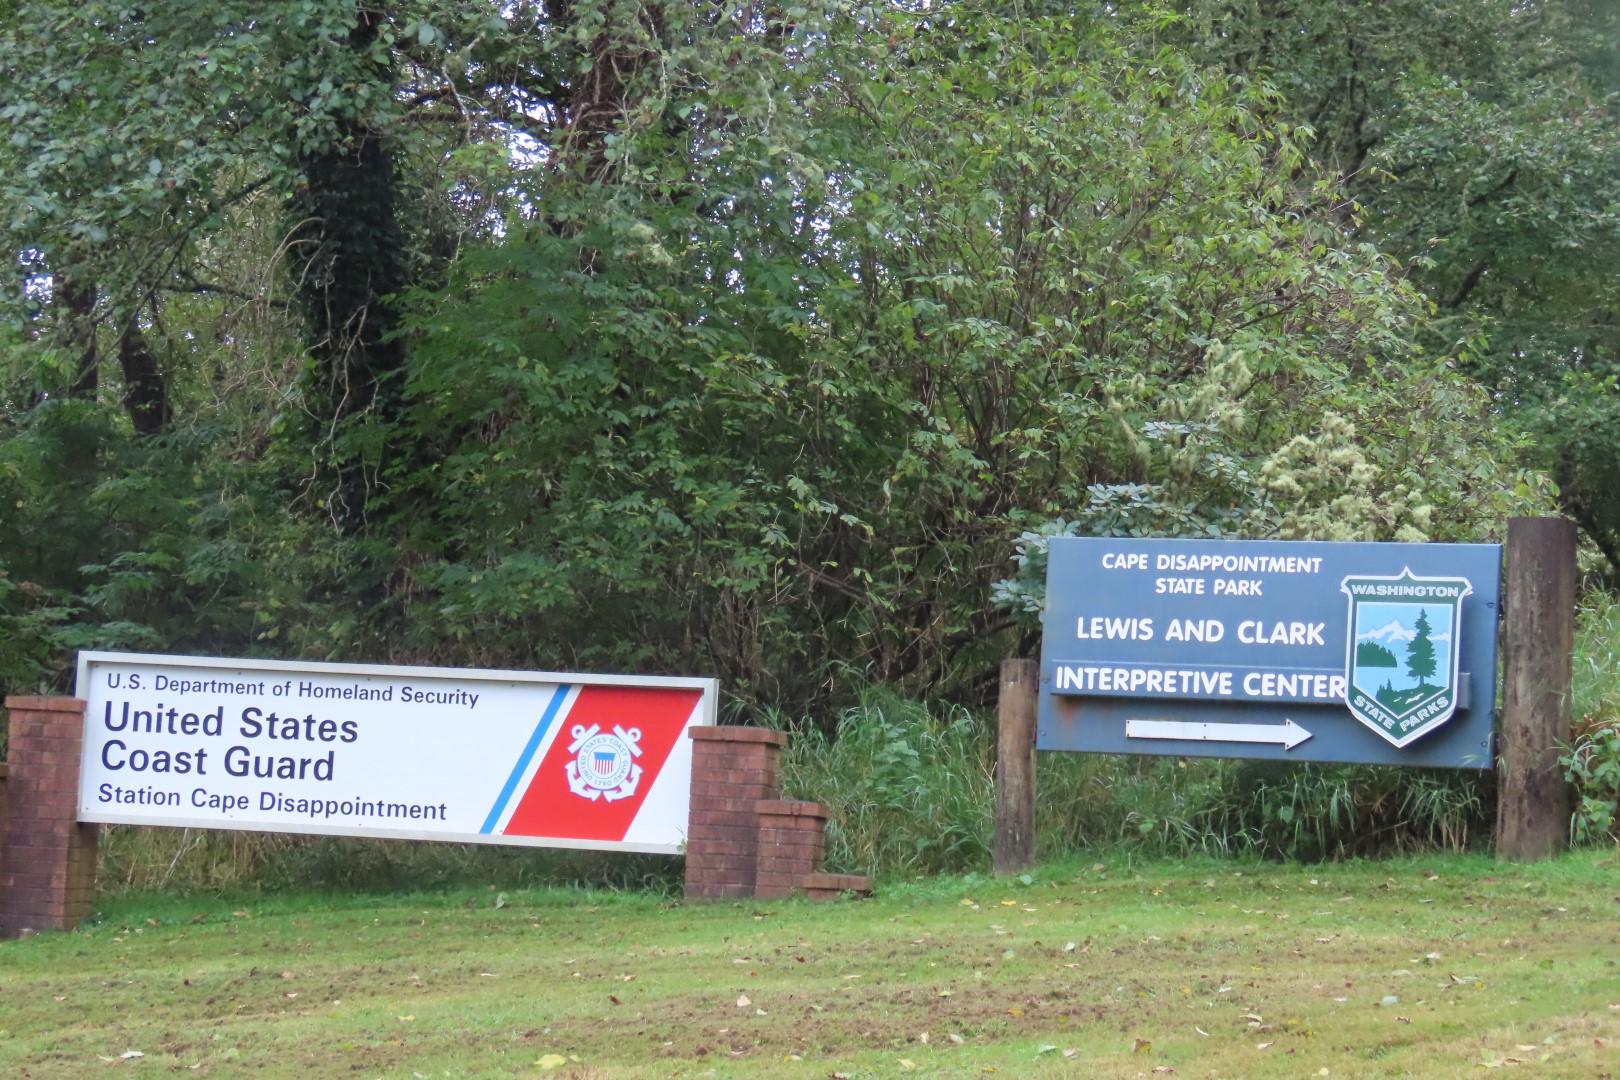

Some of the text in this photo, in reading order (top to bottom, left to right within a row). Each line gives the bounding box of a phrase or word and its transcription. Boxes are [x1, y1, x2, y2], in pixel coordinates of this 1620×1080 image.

[1102, 553, 1322, 573] CAPE DISAPPOINTMENT
[1156, 578, 1262, 596] STATE PARK
[1352, 585, 1459, 597] WASHINGTON
[1077, 617, 1325, 646] LEWIS AND CLARK
[107, 673, 479, 708] U.S. Department of Homeland Security
[1056, 666, 1345, 698] INTERPRETIVE CENTER
[104, 700, 359, 743] United States
[1354, 695, 1449, 732] STATE PARKS
[101, 739, 335, 781] Coast Guard
[580, 737, 628, 783] UNITED STATES COAST GUARD
[98, 783, 447, 820] Station Cape Disappointment
